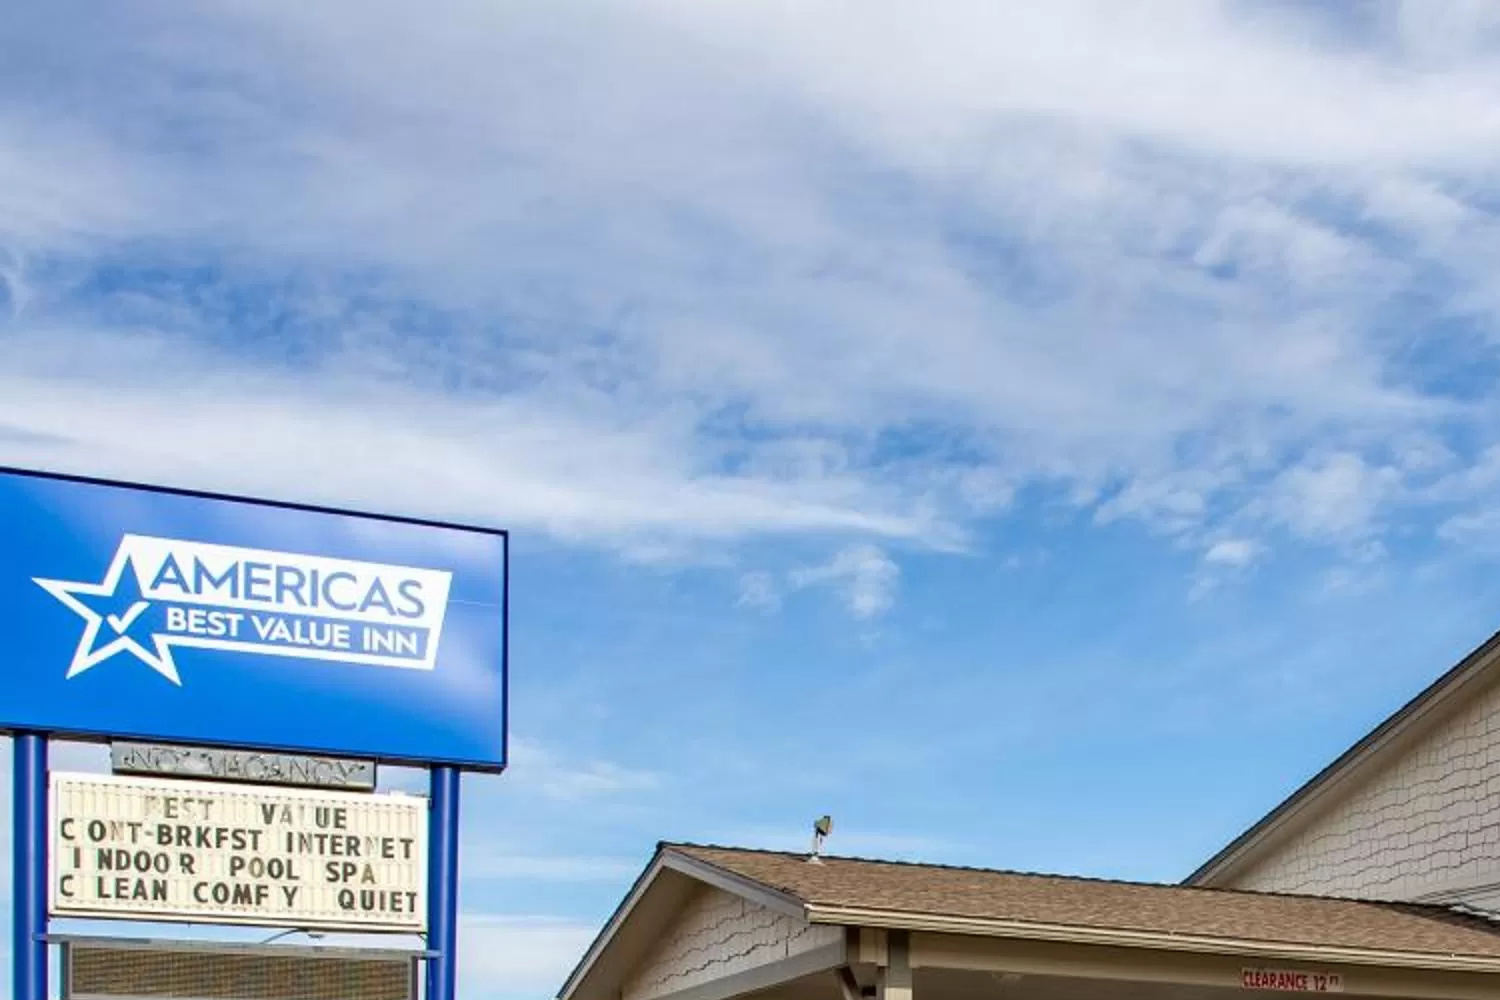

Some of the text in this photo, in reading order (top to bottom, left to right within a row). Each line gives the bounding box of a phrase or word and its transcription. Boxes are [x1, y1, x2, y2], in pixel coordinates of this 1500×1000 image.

[149, 551, 426, 619] AMERICAS
[167, 607, 418, 655] BEST VALUE INN
[201, 753, 366, 785] VACANCY
[261, 803, 347, 829] VAUE
[287, 831, 414, 860] INTERNET
[74, 847, 376, 885] INDOOR POOL SPA
[60, 874, 417, 913] CLEAN COMFY QUIET
[1243, 971, 1307, 989] CLEARANCE
[1314, 975, 1327, 991] 12
